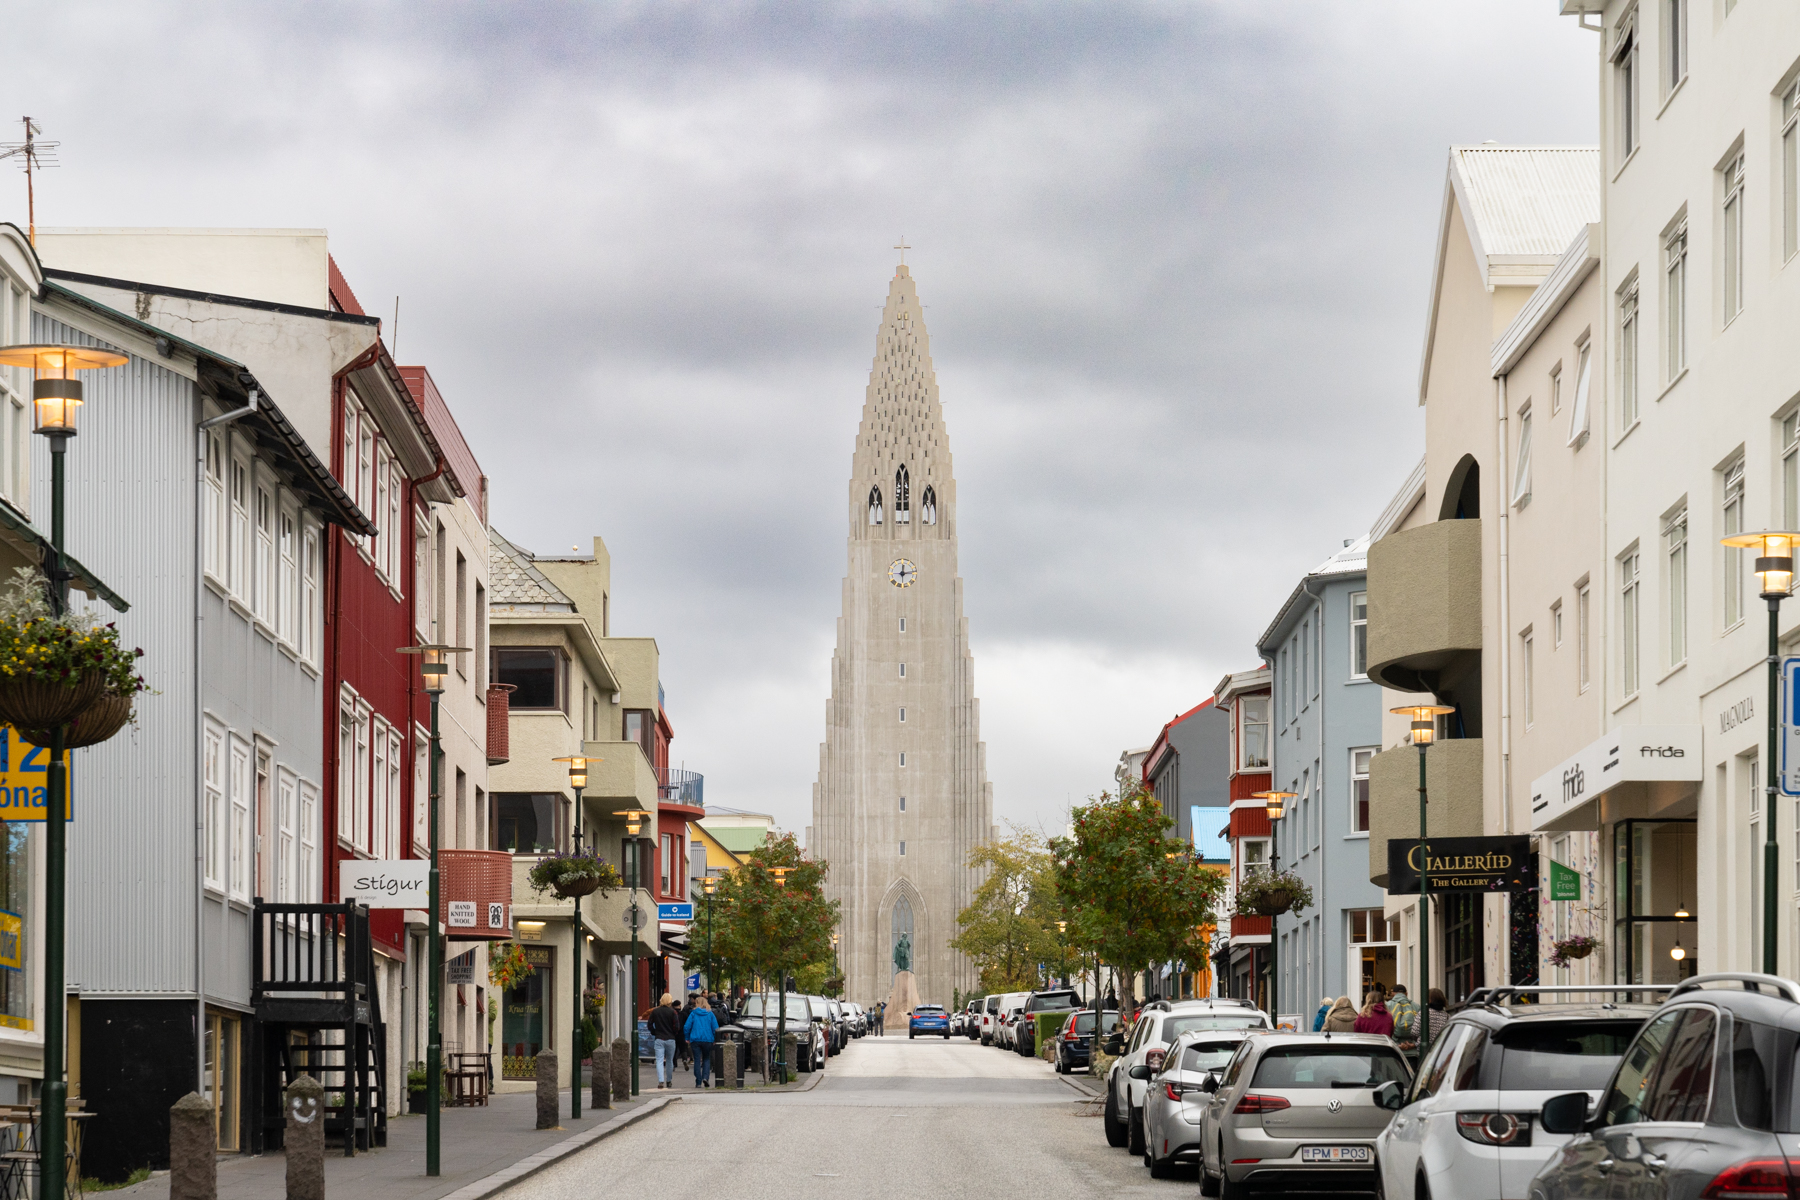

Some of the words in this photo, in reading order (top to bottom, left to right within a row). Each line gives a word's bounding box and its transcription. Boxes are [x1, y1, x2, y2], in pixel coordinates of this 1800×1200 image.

[1720, 696, 1754, 735] MAGNOLIA
[353, 874, 423, 896] Stígur
[1432, 878, 1449, 887] THE
[1451, 878, 1489, 886] GALLERY
[1557, 882, 1575, 890] Free
[1312, 1148, 1331, 1158] PM
